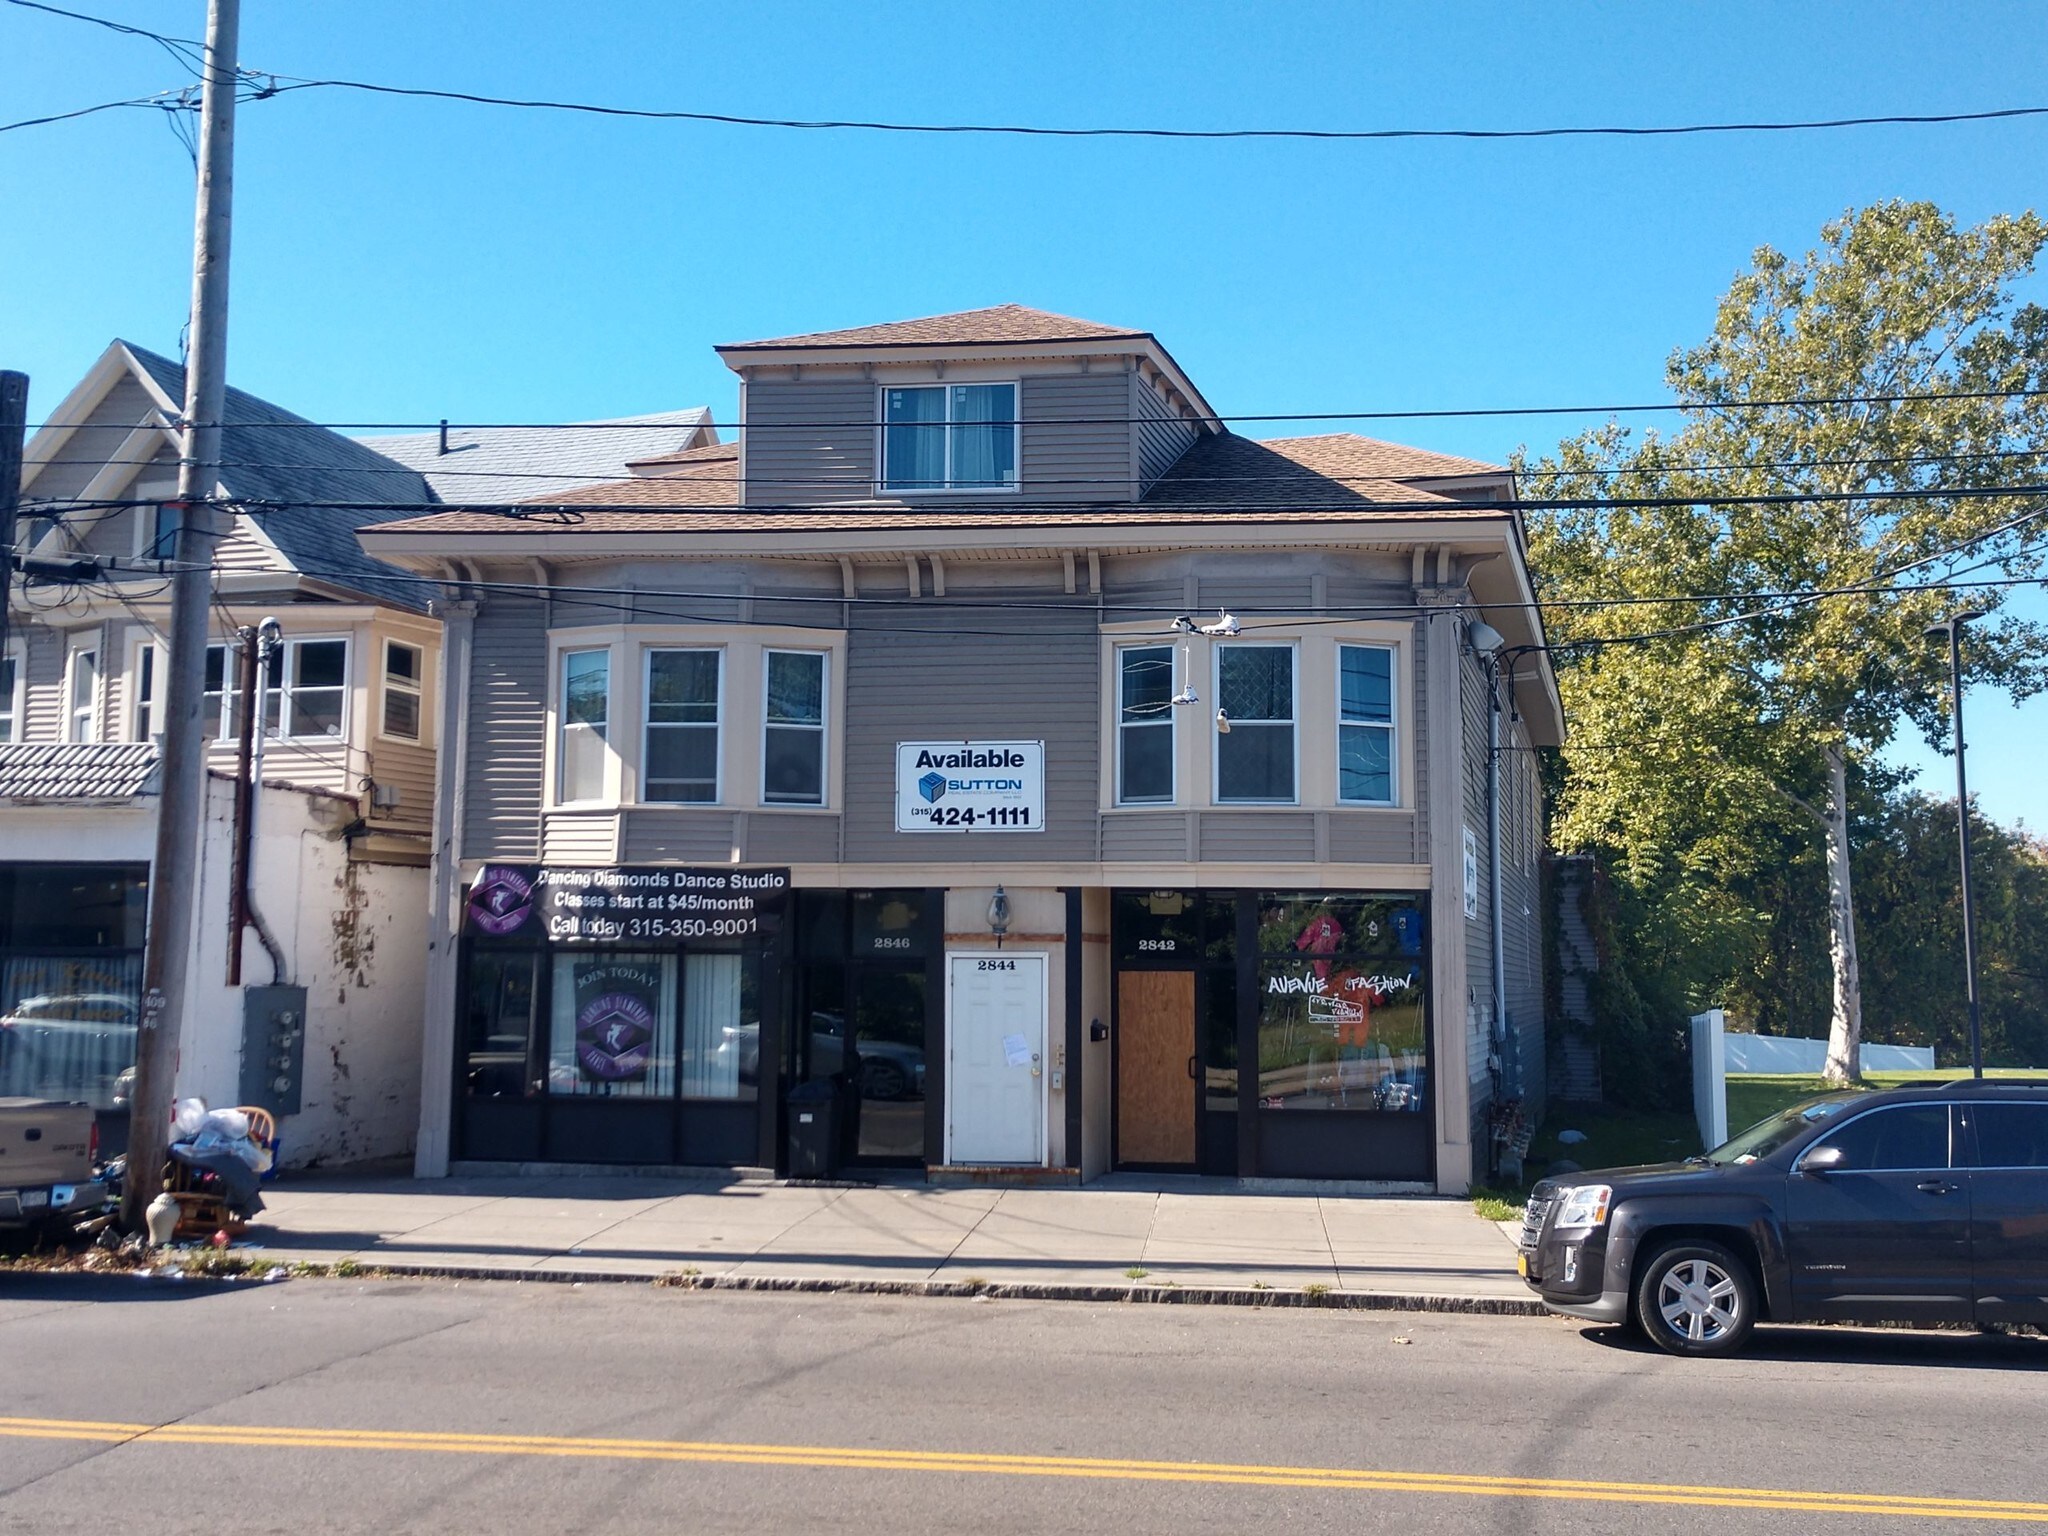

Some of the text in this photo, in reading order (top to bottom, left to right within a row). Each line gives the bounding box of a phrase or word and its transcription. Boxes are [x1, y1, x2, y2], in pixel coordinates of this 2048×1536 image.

[915, 749, 1025, 768] Available
[947, 780, 1022, 790] SUTTON
[911, 807, 1029, 825] (315) 424-1111
[538, 870, 785, 889] Dancing Diamonds Dance Studio
[554, 892, 754, 910] Classes start at $45/month
[550, 915, 757, 936] Call today 315-350-9001
[874, 937, 910, 948] 2846
[1139, 940, 1175, 950] 2842
[978, 960, 1016, 970] 2844
[578, 967, 658, 988] JOIN TODAY
